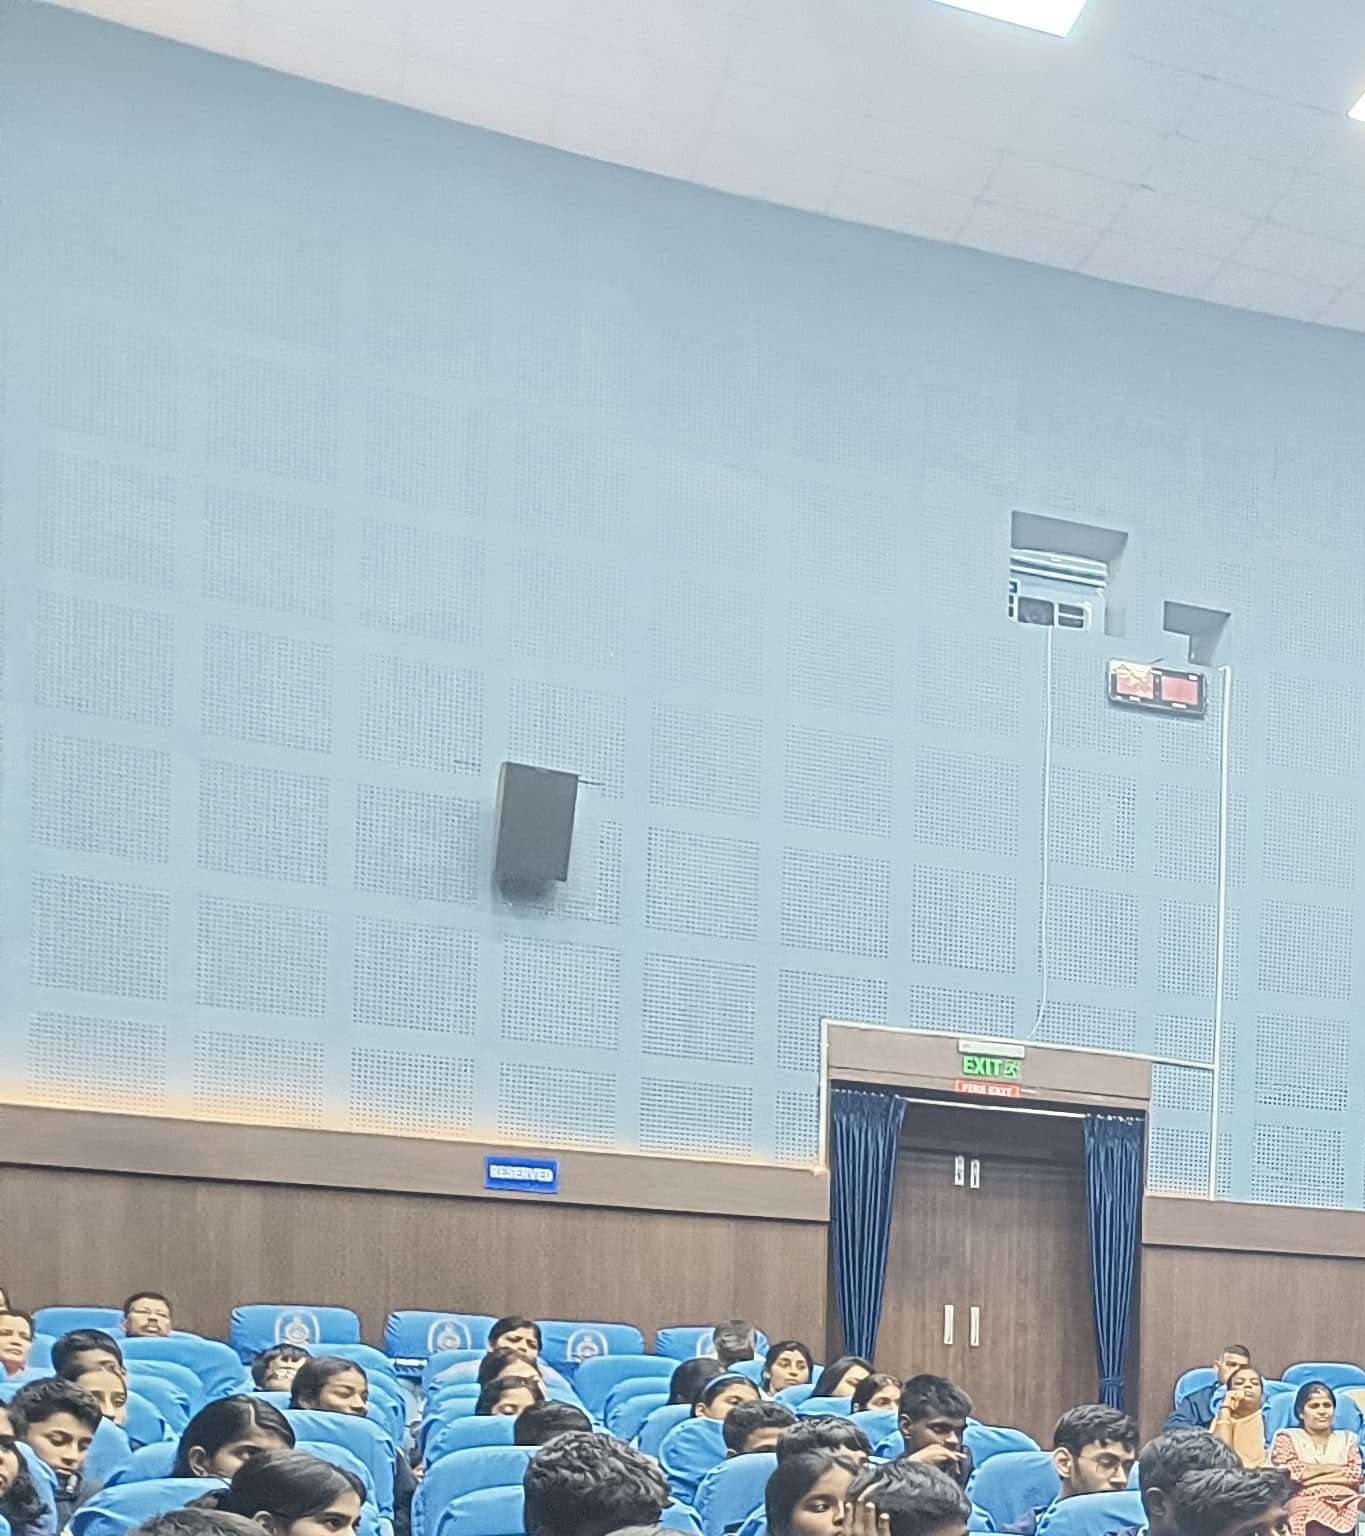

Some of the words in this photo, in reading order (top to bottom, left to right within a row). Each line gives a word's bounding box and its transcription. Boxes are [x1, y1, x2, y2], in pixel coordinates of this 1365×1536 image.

[963, 1055, 1003, 1076] EXIT
[961, 1083, 987, 1095] FIRE
[988, 1085, 1013, 1097] EXIT
[489, 1164, 554, 1183] RESERVED
